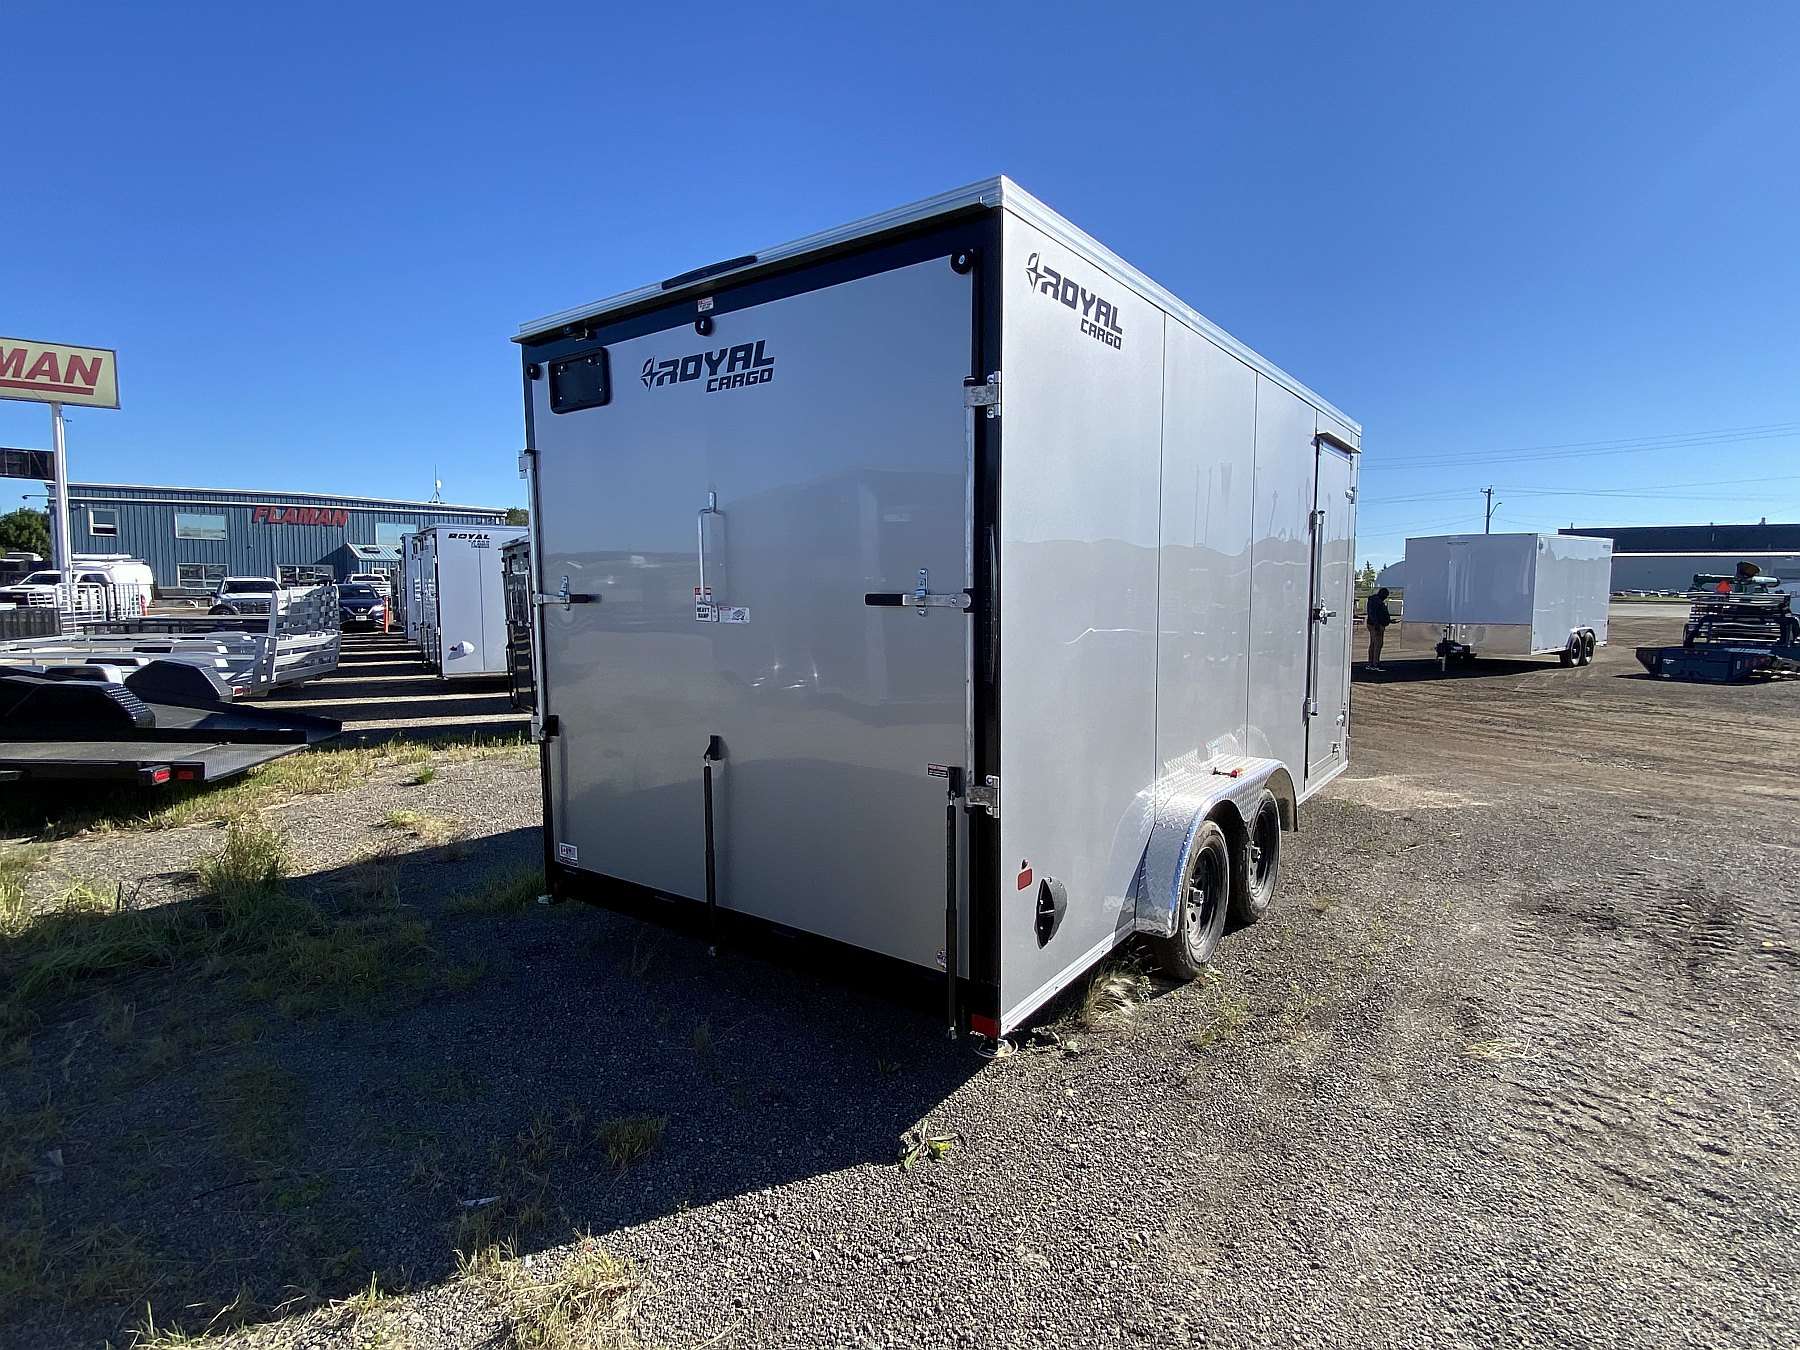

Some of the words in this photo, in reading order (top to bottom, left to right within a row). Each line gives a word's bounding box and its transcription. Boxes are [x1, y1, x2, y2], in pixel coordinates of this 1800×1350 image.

[1040, 265, 1123, 335] ROYAL
[1080, 317, 1122, 350] CARGO
[0, 346, 103, 387] MAN
[655, 339, 775, 387] ROYAL
[705, 367, 774, 393] CARGO
[252, 505, 349, 528] FLAMAN
